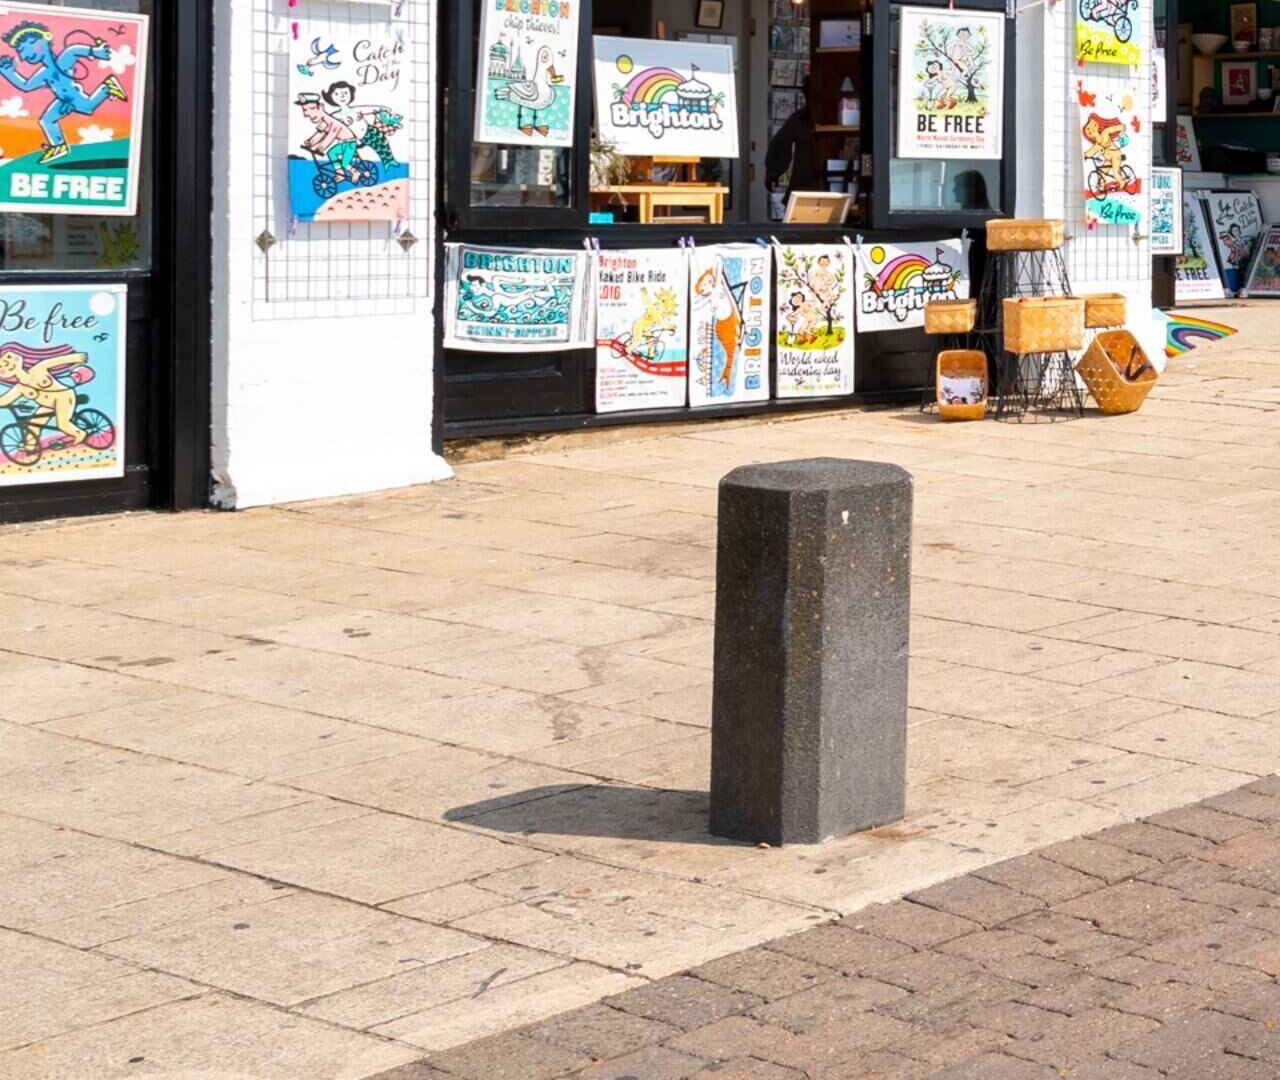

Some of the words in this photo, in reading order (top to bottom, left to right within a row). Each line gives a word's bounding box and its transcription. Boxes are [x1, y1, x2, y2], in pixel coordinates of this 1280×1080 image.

[503, 13, 524, 37] chip
[525, 16, 561, 36] thieves!
[352, 39, 404, 63] Catch
[1081, 39, 1094, 56] Be
[1095, 41, 1118, 60] free
[355, 63, 400, 93] Day
[610, 101, 723, 139] Brighton
[916, 114, 937, 132] BE
[944, 115, 985, 134] FREE
[10, 172, 50, 198] BE
[52, 174, 125, 201] FREE
[1100, 202, 1114, 219] Be
[1114, 204, 1136, 224] free
[463, 251, 573, 274] BRIGHTON
[598, 255, 637, 272] Brighton
[627, 271, 645, 284] Bike
[647, 270, 667, 283] Ride
[1184, 267, 1210, 281] FREE
[0, 299, 40, 332] Be
[42, 301, 100, 344] free
[744, 257, 765, 390] BRIGHTON
[779, 351, 812, 366] World
[813, 350, 839, 365] naked
[778, 364, 822, 382] ardening
[823, 364, 842, 382] day
